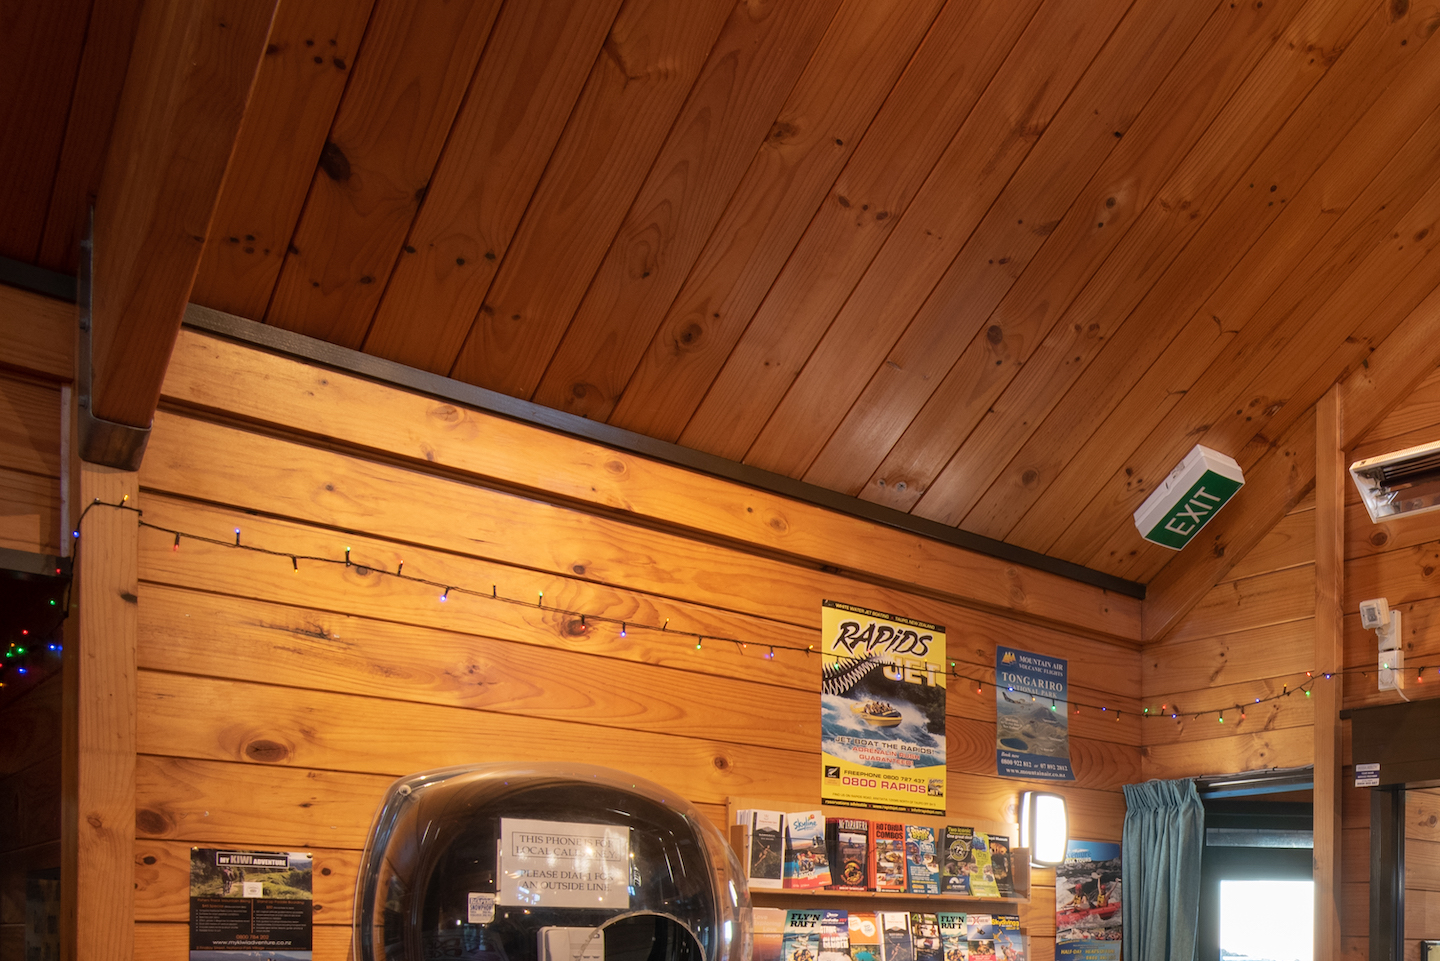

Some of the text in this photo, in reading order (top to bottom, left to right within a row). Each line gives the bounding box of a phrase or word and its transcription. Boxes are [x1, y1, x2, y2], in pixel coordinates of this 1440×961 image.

[1164, 486, 1221, 536] EXIT
[1019, 655, 1063, 671] MOUNTAIN AIR
[882, 656, 941, 687] JET
[1019, 663, 1063, 677] VOLCANIC FLIGHTS
[1001, 672, 1063, 692] TONGARIRO
[1008, 683, 1039, 695] NATIONAL
[852, 746, 921, 760] ADRENALIN RUSH
[854, 739, 879, 747] BOAT
[901, 745, 935, 755] RAPIDS!
[859, 754, 914, 766] GUARANTEED!
[844, 770, 881, 779] FREEPHONE
[842, 776, 926, 794] 0800 RAPIDS
[875, 823, 904, 832] ROTORUA
[520, 835, 543, 843] THIS
[546, 836, 582, 846] PHONE
[876, 830, 904, 840] COMBOS
[516, 846, 552, 855] LOCAL
[554, 847, 583, 857] CALL
[230, 855, 253, 864] KIWI
[520, 869, 558, 878] PLEASE
[560, 871, 585, 879] DIAL
[587, 872, 592, 881] 1
[522, 880, 612, 892] AN OUTSIDE LINE.
